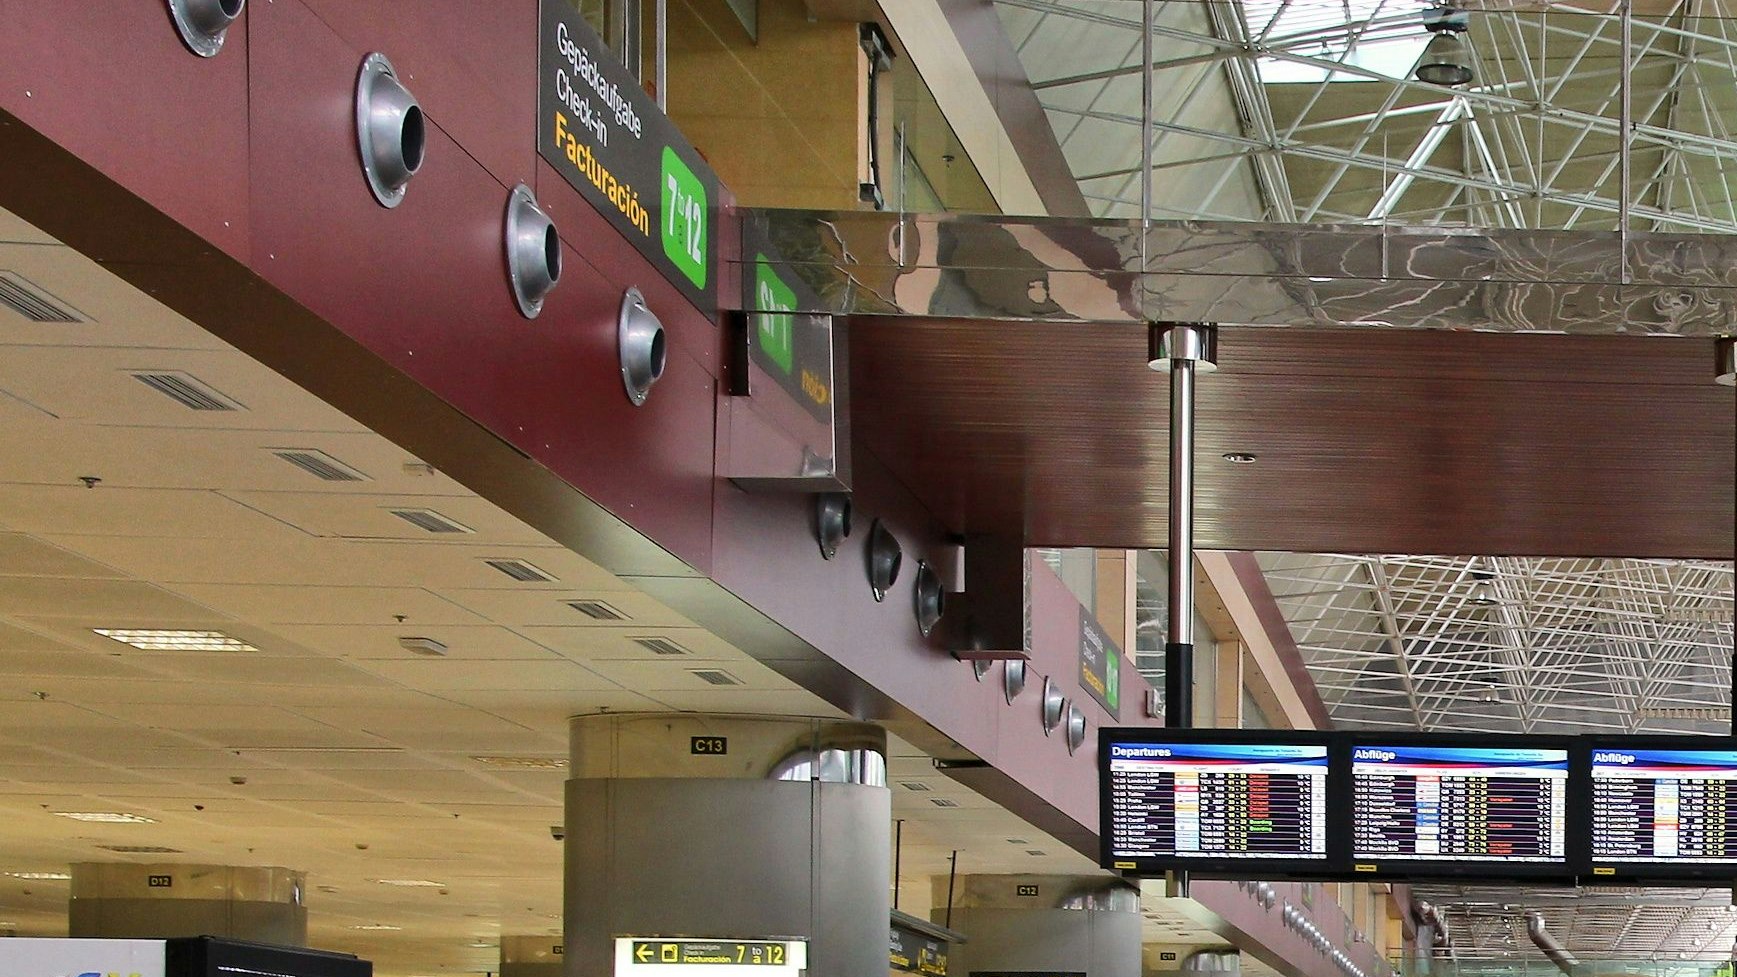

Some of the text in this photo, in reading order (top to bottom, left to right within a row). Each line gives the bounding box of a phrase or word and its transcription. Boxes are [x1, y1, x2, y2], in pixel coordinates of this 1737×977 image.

[556, 21, 642, 141] Gepäckaufgabe
[555, 68, 609, 148] Check-in
[554, 111, 650, 238] Facturación
[667, 172, 678, 237] 7
[683, 196, 702, 265] 12
[695, 739, 723, 752] C13
[1111, 746, 1172, 758] Departures
[1353, 749, 1396, 762] Abflüge
[1593, 752, 1636, 765] Abflüge
[1018, 886, 1038, 896] C12
[736, 945, 745, 963] 7
[766, 945, 783, 964] 12
